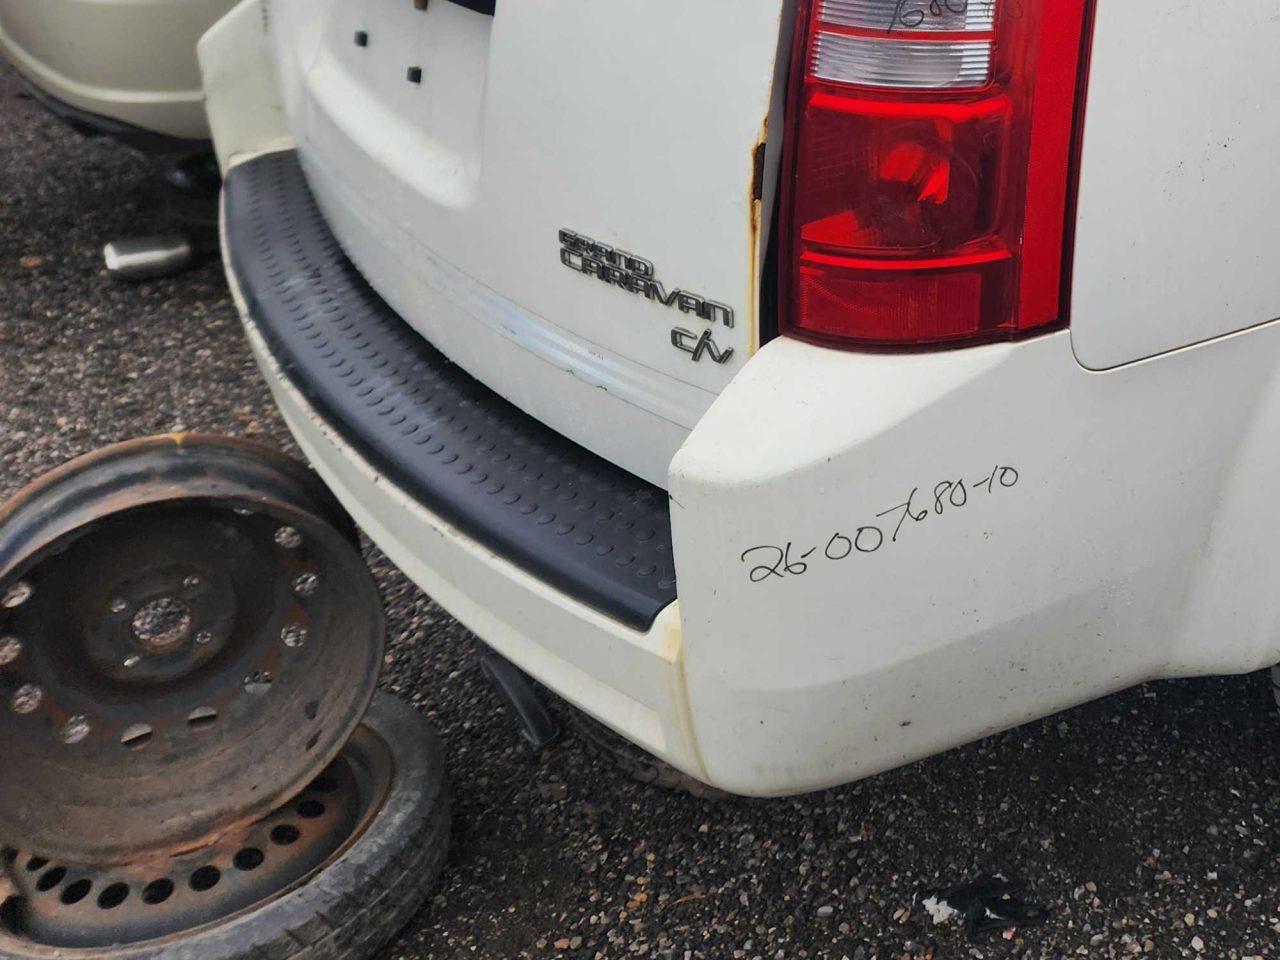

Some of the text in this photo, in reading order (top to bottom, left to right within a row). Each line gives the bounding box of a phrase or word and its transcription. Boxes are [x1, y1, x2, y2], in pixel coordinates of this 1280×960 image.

[558, 227, 655, 278] GRAND
[560, 246, 735, 329] CARAVAN
[740, 465, 1019, 582] 26-007680-10
